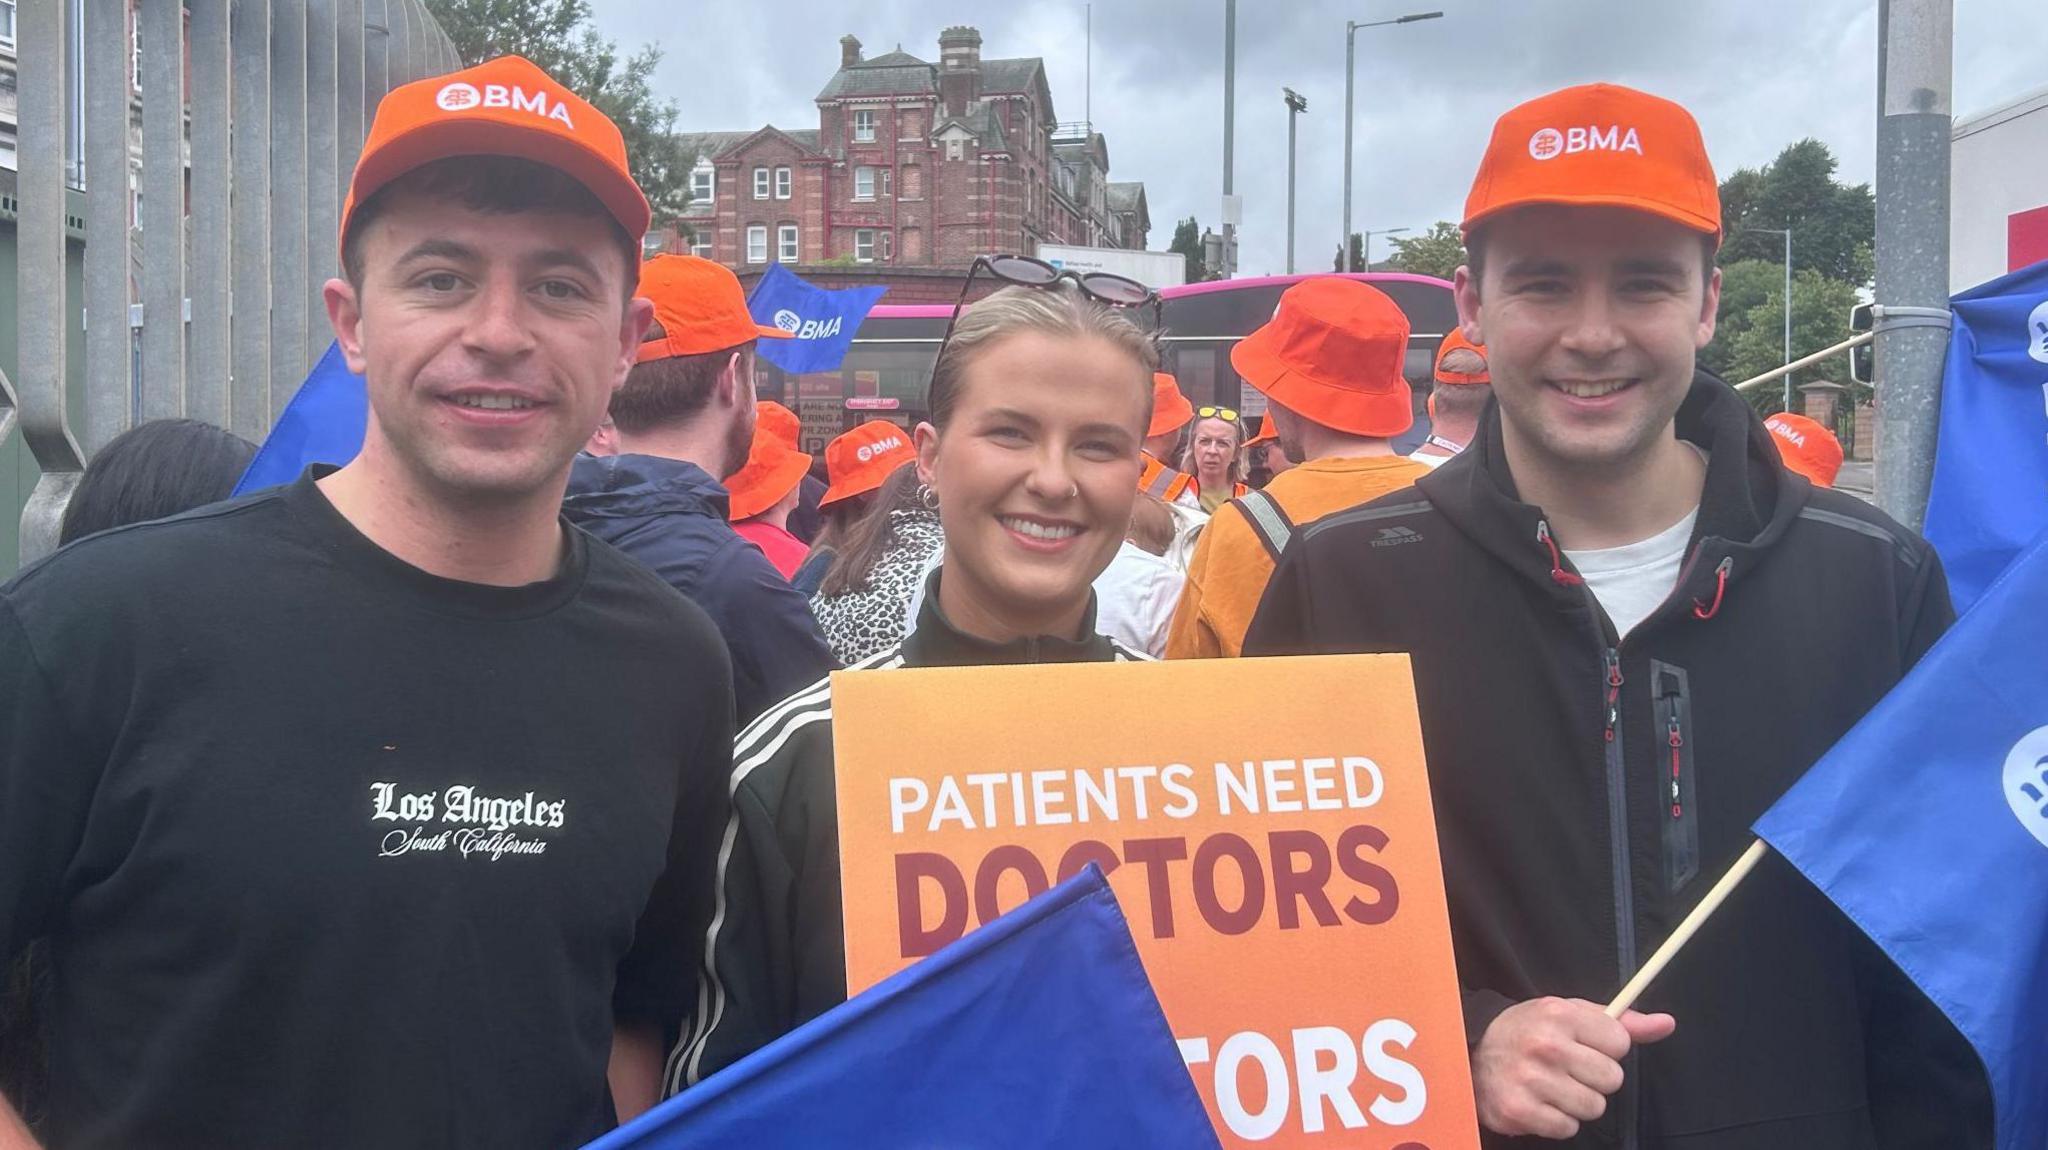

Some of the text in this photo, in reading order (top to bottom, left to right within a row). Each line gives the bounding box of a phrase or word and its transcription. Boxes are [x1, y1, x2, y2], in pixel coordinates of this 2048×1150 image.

[483, 85, 574, 130] BMA
[1565, 125, 1643, 156] BMA
[798, 316, 842, 340] BMA
[871, 436, 902, 455] BMA
[1777, 423, 1805, 448] BMA
[370, 782, 566, 831] Los Angeles
[889, 756, 1385, 833] PATIENTS NEED
[378, 826, 547, 862] South California
[894, 824, 1400, 959] DOTORS
